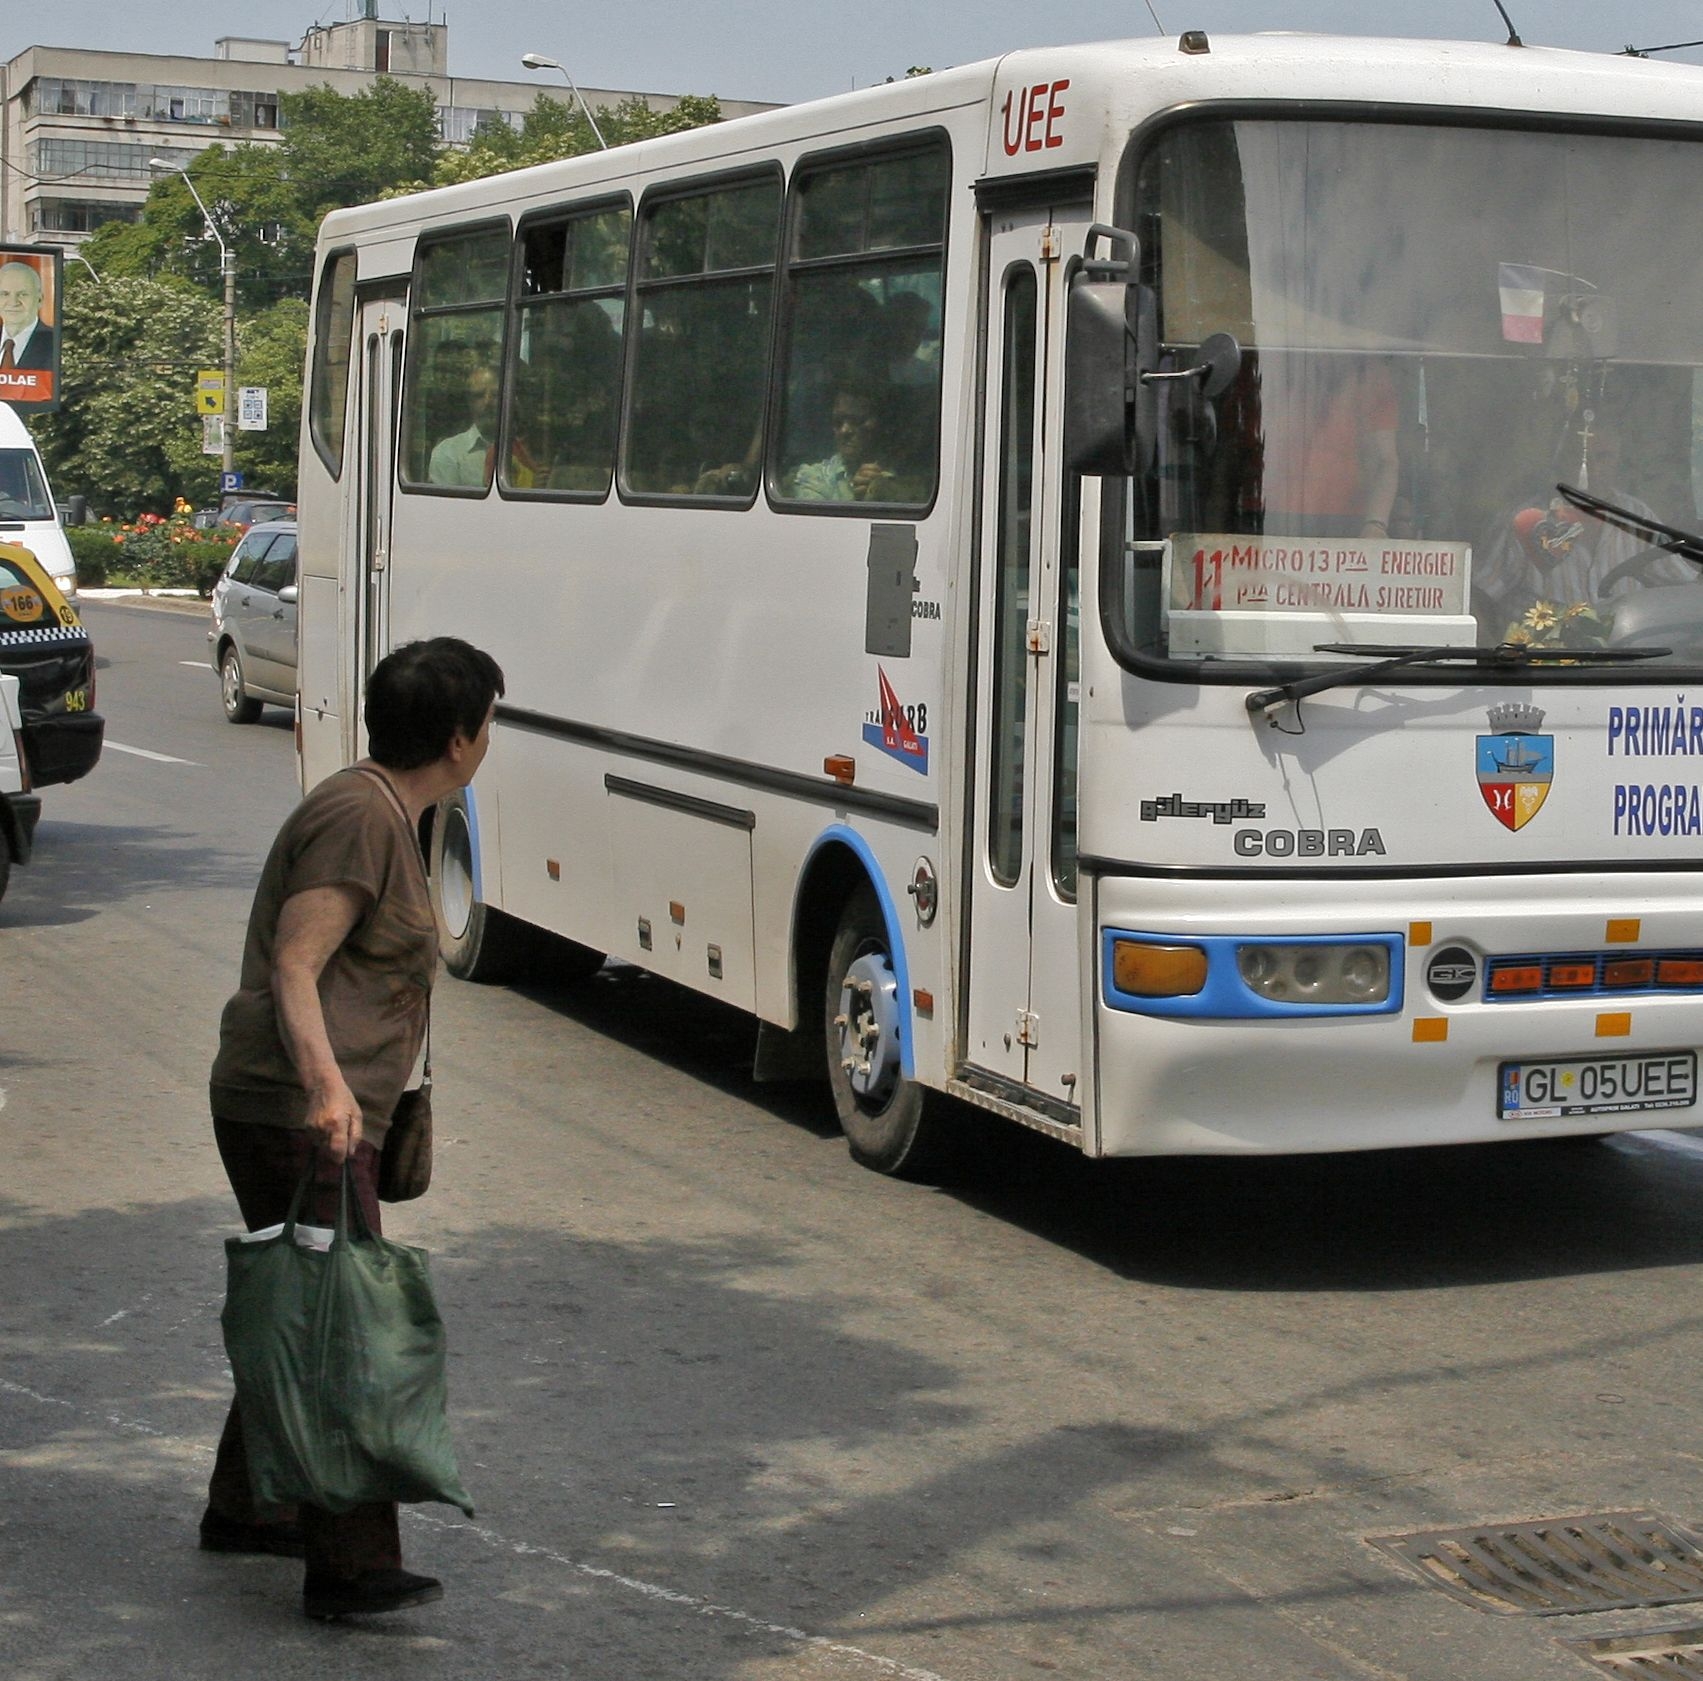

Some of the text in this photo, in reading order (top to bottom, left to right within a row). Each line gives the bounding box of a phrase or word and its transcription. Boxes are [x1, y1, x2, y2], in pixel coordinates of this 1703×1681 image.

[1002, 79, 1070, 157] UEE
[1380, 551, 1455, 577] ENERGIEI
[11, 595, 34, 611] 166
[1276, 582, 1370, 609] CENTRALA
[66, 691, 85, 712] 943
[1234, 828, 1387, 858] COBRA
